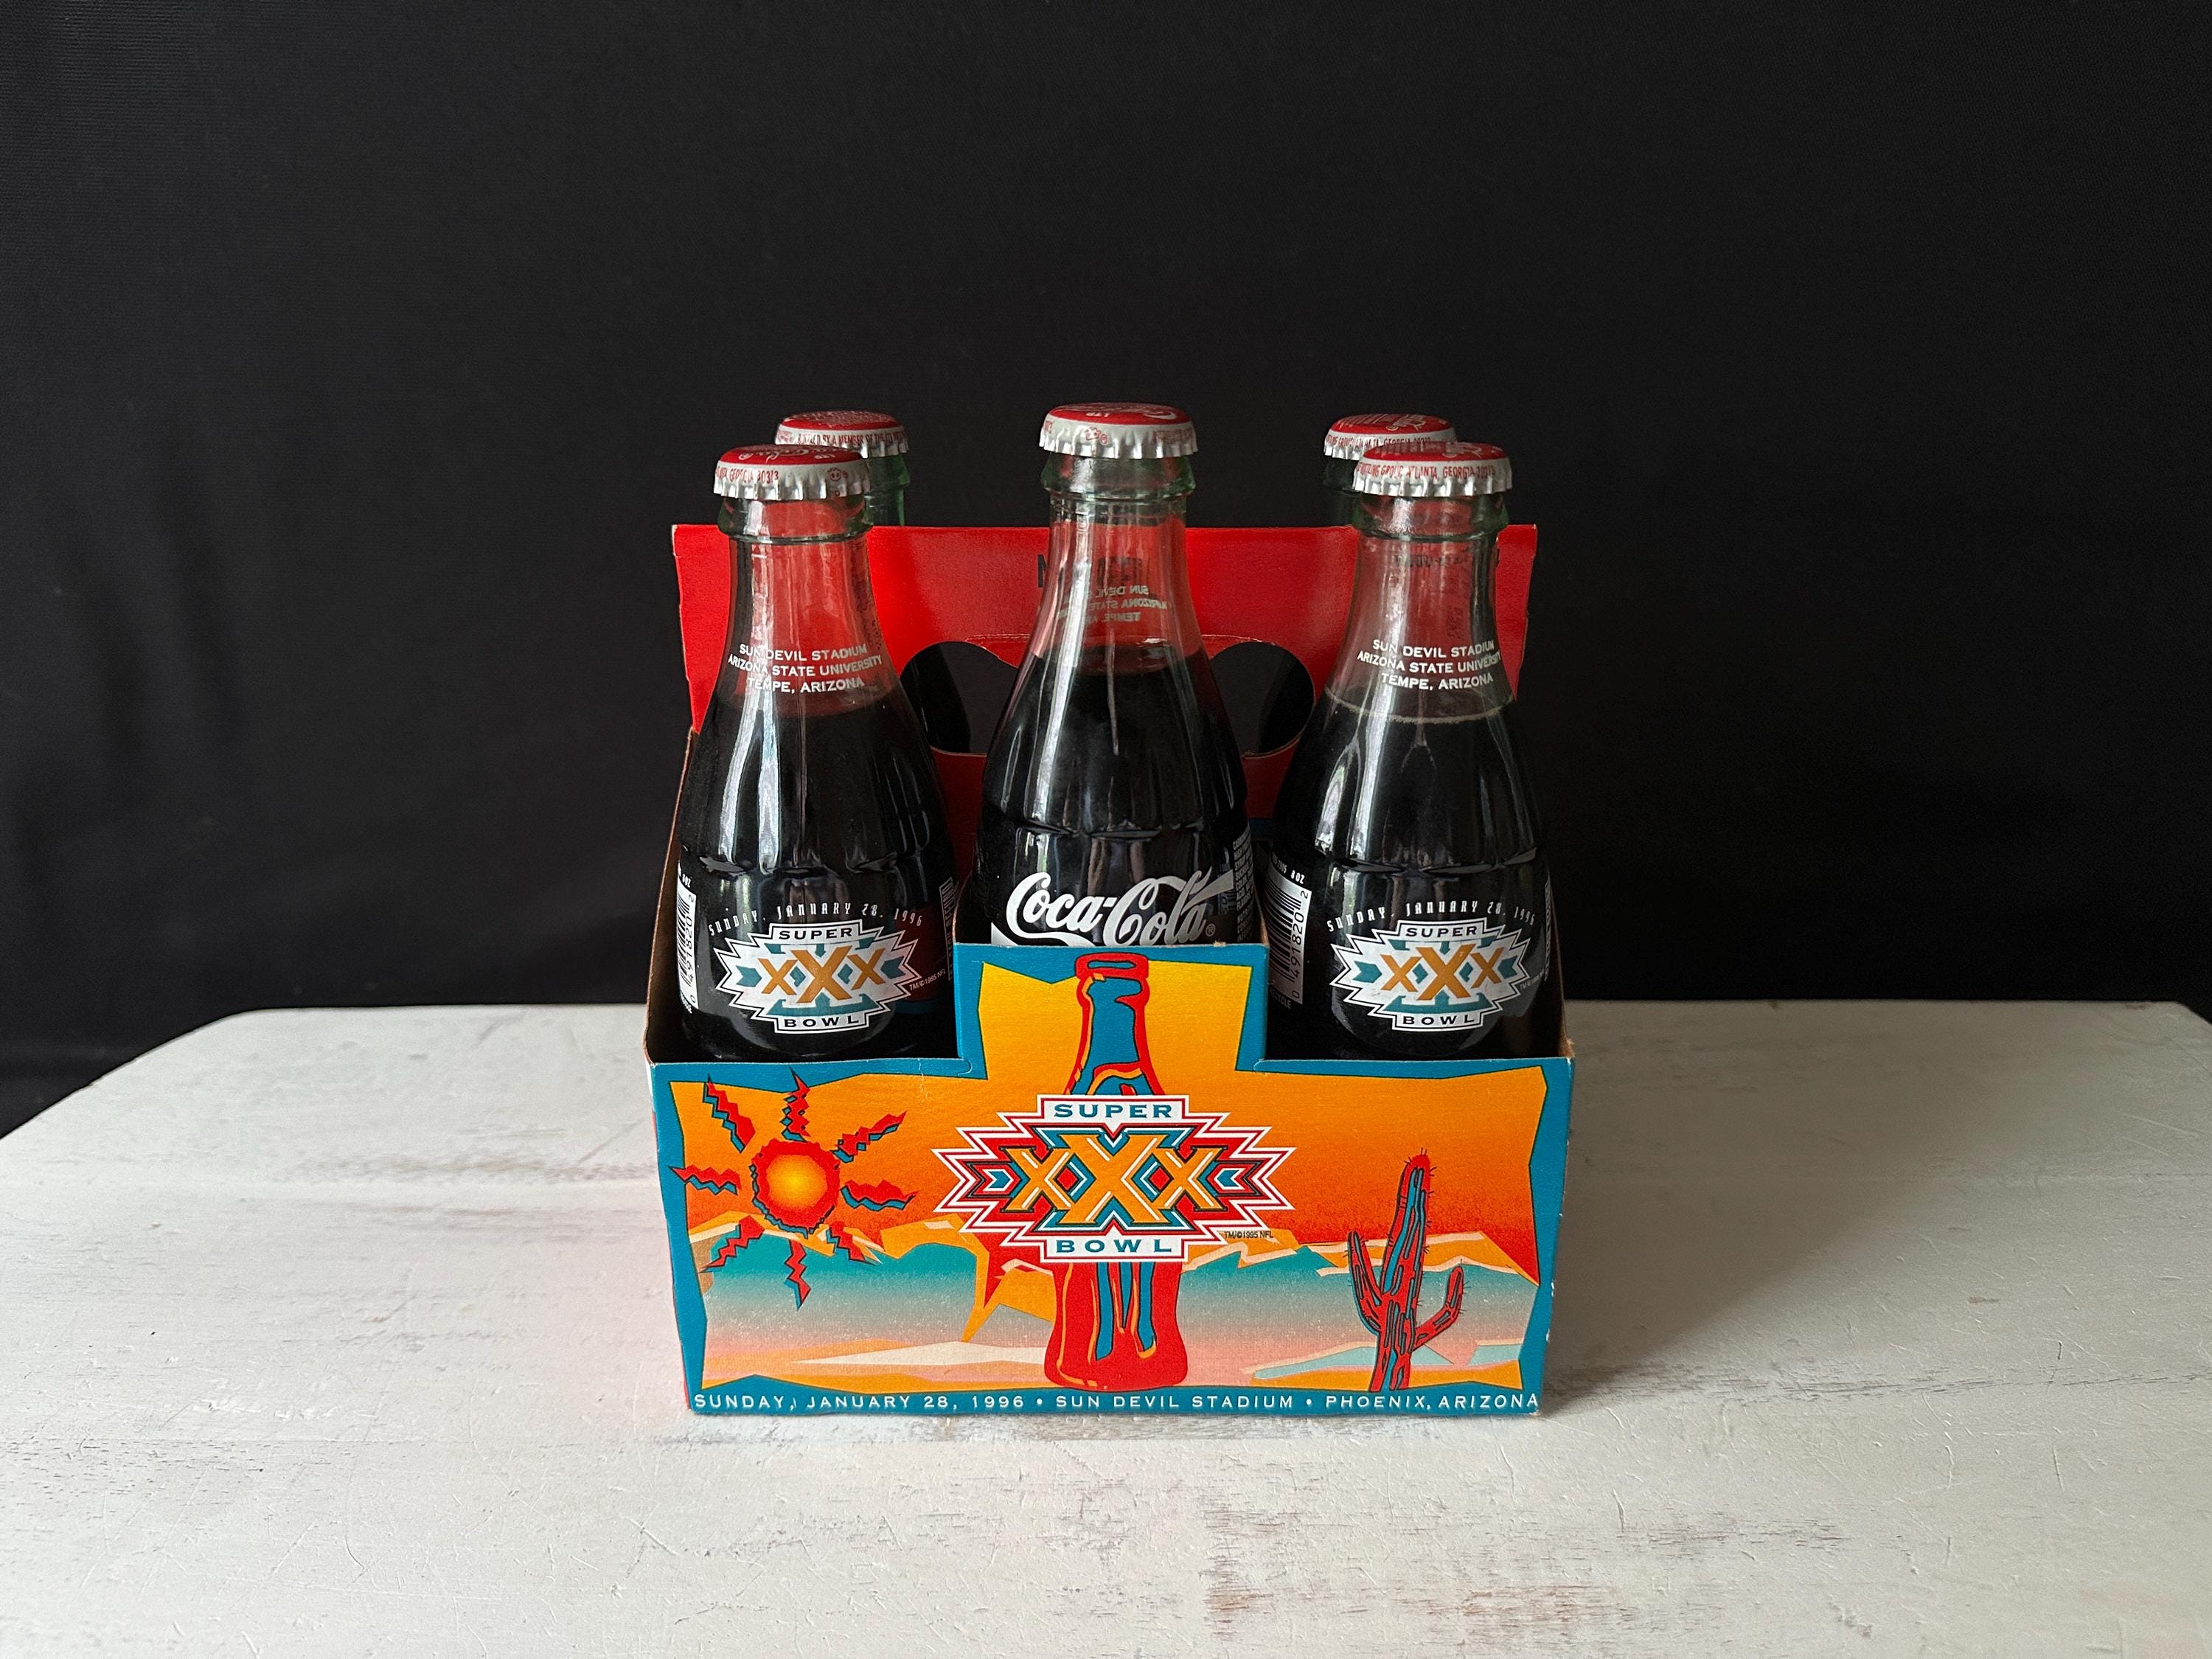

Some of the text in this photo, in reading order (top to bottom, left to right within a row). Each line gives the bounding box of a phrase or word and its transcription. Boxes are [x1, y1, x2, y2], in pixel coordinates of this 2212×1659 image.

[757, 470, 779, 484] 30313
[1442, 466, 1475, 479] GEORGIA
[739, 643, 867, 661] SUN DEVIL STADIUM
[1373, 639, 1495, 658] SUN DEVIL STADIUM
[727, 653, 883, 677] ARIZONA STATE UNIVERSITY
[1357, 650, 1405, 672] ARIZONA
[1409, 662, 1453, 674] STATE
[747, 676, 866, 695] TEMPE, ARIZONA
[1381, 672, 1494, 691] TEMPE, ARIZONA
[777, 901, 851, 920] JANUARY
[894, 908, 923, 927] 1996
[1405, 900, 1478, 917] JANUARY
[1514, 905, 1536, 926] 1996
[779, 928, 853, 940] SUPER
[1405, 926, 1478, 938] SUPER
[757, 945, 886, 1004] XXX
[1380, 943, 1504, 1001] XXX
[784, 1015, 860, 1029] BOWL
[1402, 1014, 1475, 1026] BOWL
[1053, 1104, 1172, 1119] SUPER
[998, 1133, 1228, 1225] XXX
[1259, 1230, 1274, 1239] NFL
[1056, 1239, 1172, 1253] BOWL
[693, 1392, 1539, 1411] SUNDAY, JANUARY 28, 1996 SUN DEVIL STADIUM PHOENIX, ARIZONA
